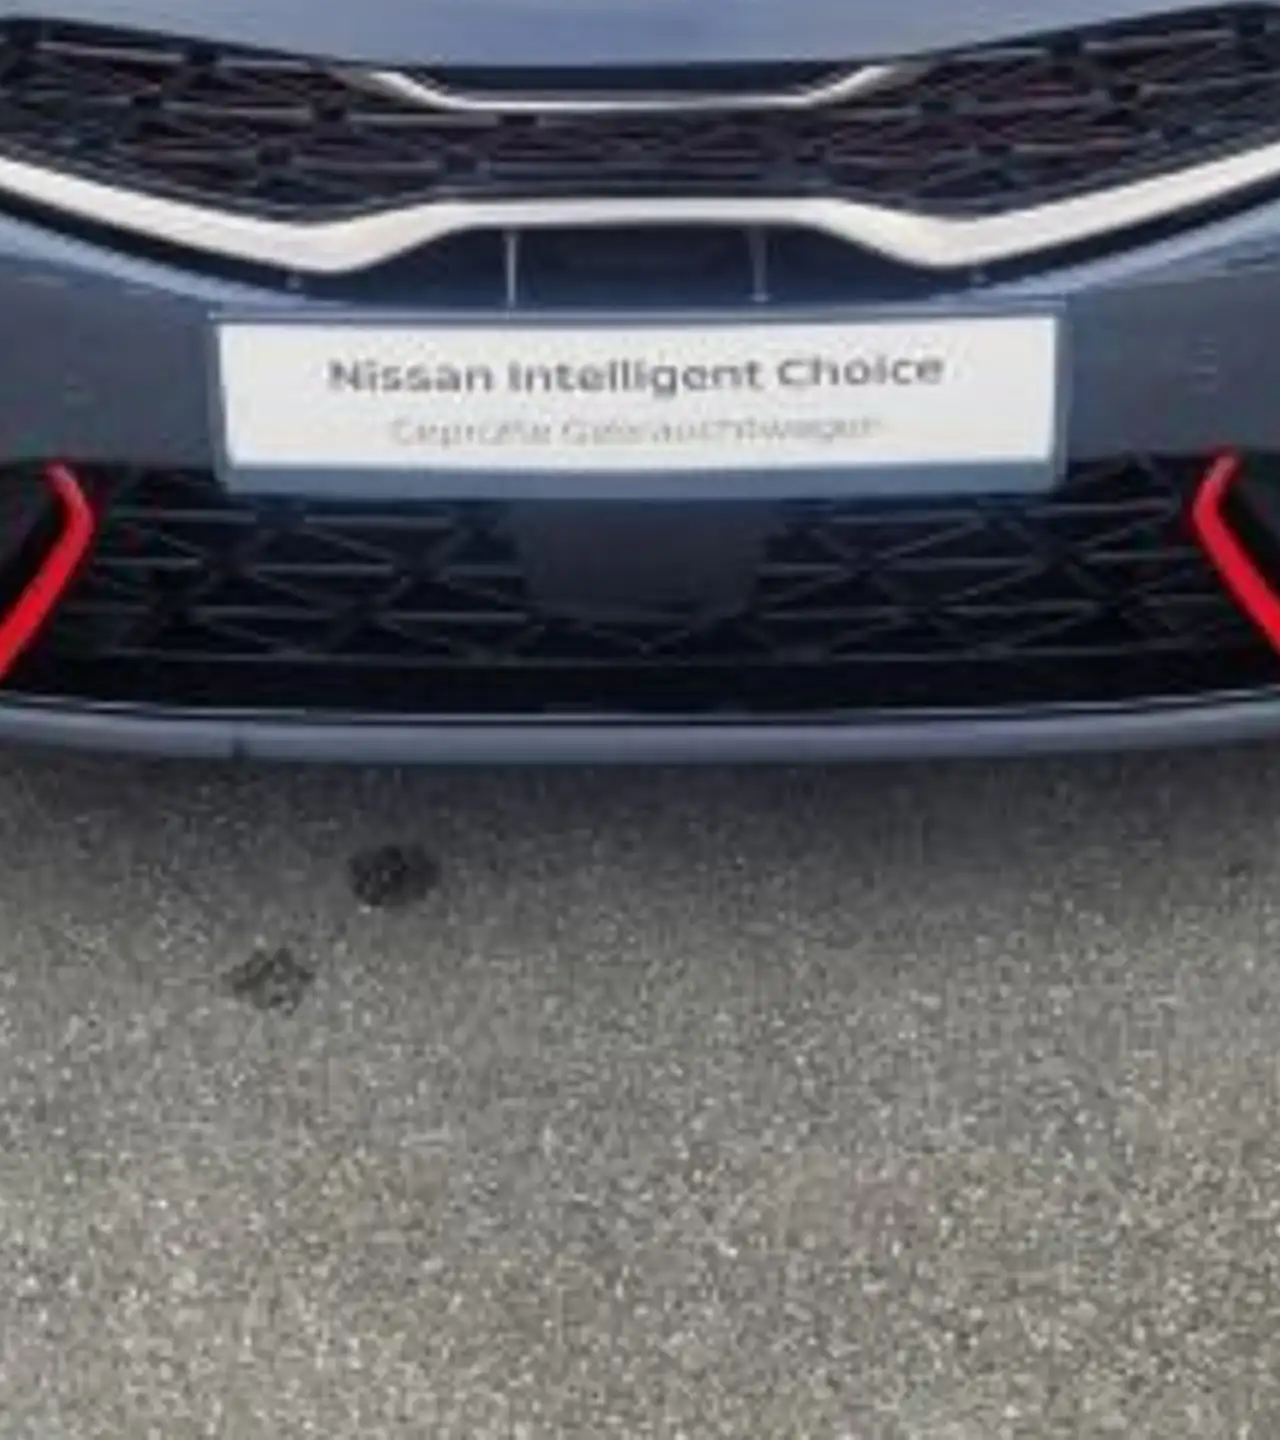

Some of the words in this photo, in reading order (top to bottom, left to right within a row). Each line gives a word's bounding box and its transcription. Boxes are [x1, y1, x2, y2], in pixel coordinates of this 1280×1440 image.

[327, 358, 494, 393] Nissan
[508, 356, 764, 396] Intelligent
[776, 354, 944, 388] Choice
